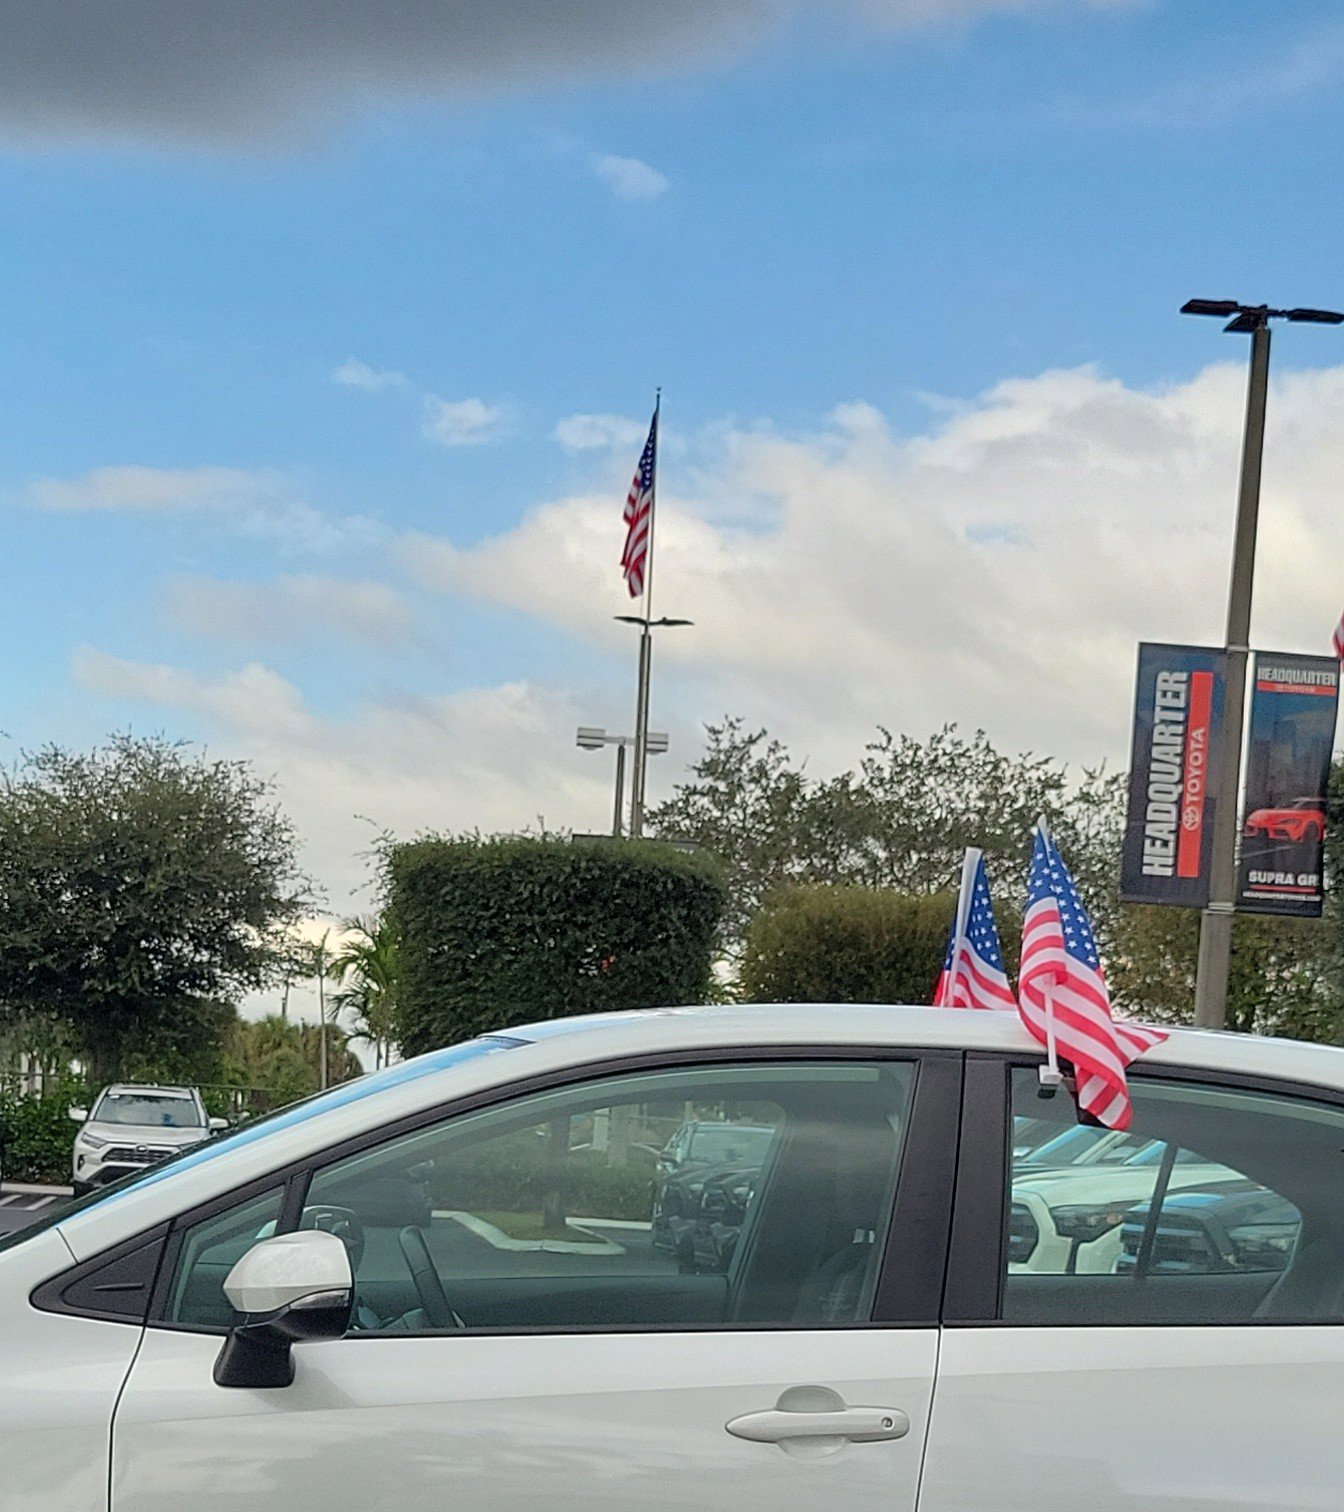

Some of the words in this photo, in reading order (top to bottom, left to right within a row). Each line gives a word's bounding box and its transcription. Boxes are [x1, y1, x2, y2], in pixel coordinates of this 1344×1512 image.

[1257, 667, 1336, 686] HEADQUARTER
[1142, 671, 1189, 876] HEADQUARTER
[1187, 727, 1206, 804] TOYOTA
[1248, 870, 1295, 886] SUPRA
[1297, 873, 1320, 887] GR
